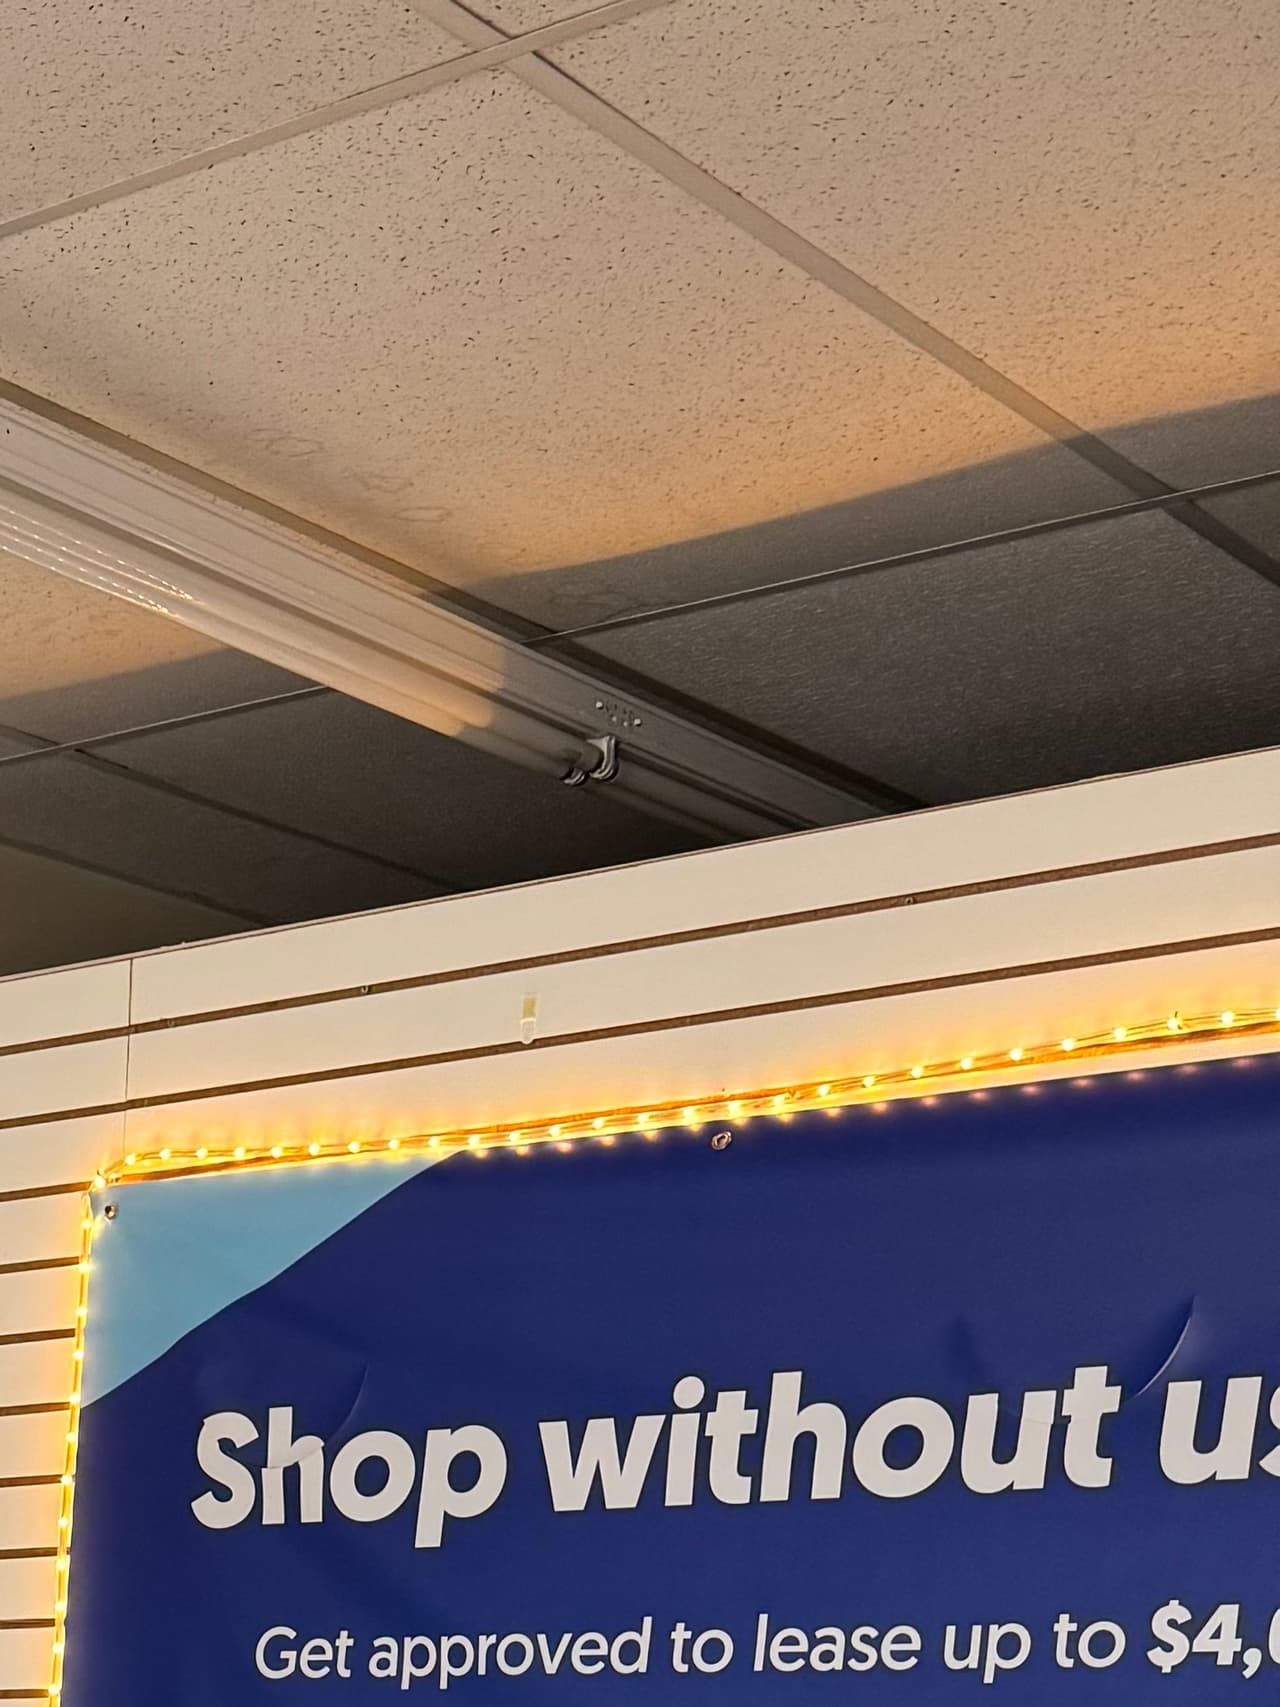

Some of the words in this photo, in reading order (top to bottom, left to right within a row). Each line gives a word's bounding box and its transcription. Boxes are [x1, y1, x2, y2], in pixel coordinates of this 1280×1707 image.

[192, 1407, 506, 1547] Shop
[539, 1366, 1121, 1511] without
[256, 1627, 353, 1678] Get
[369, 1617, 652, 1689] approved
[671, 1623, 733, 1672] to
[754, 1614, 921, 1671] lease
[944, 1623, 1031, 1683] up
[1054, 1614, 1125, 1667] to
[1147, 1600, 1279, 1678] $4,
